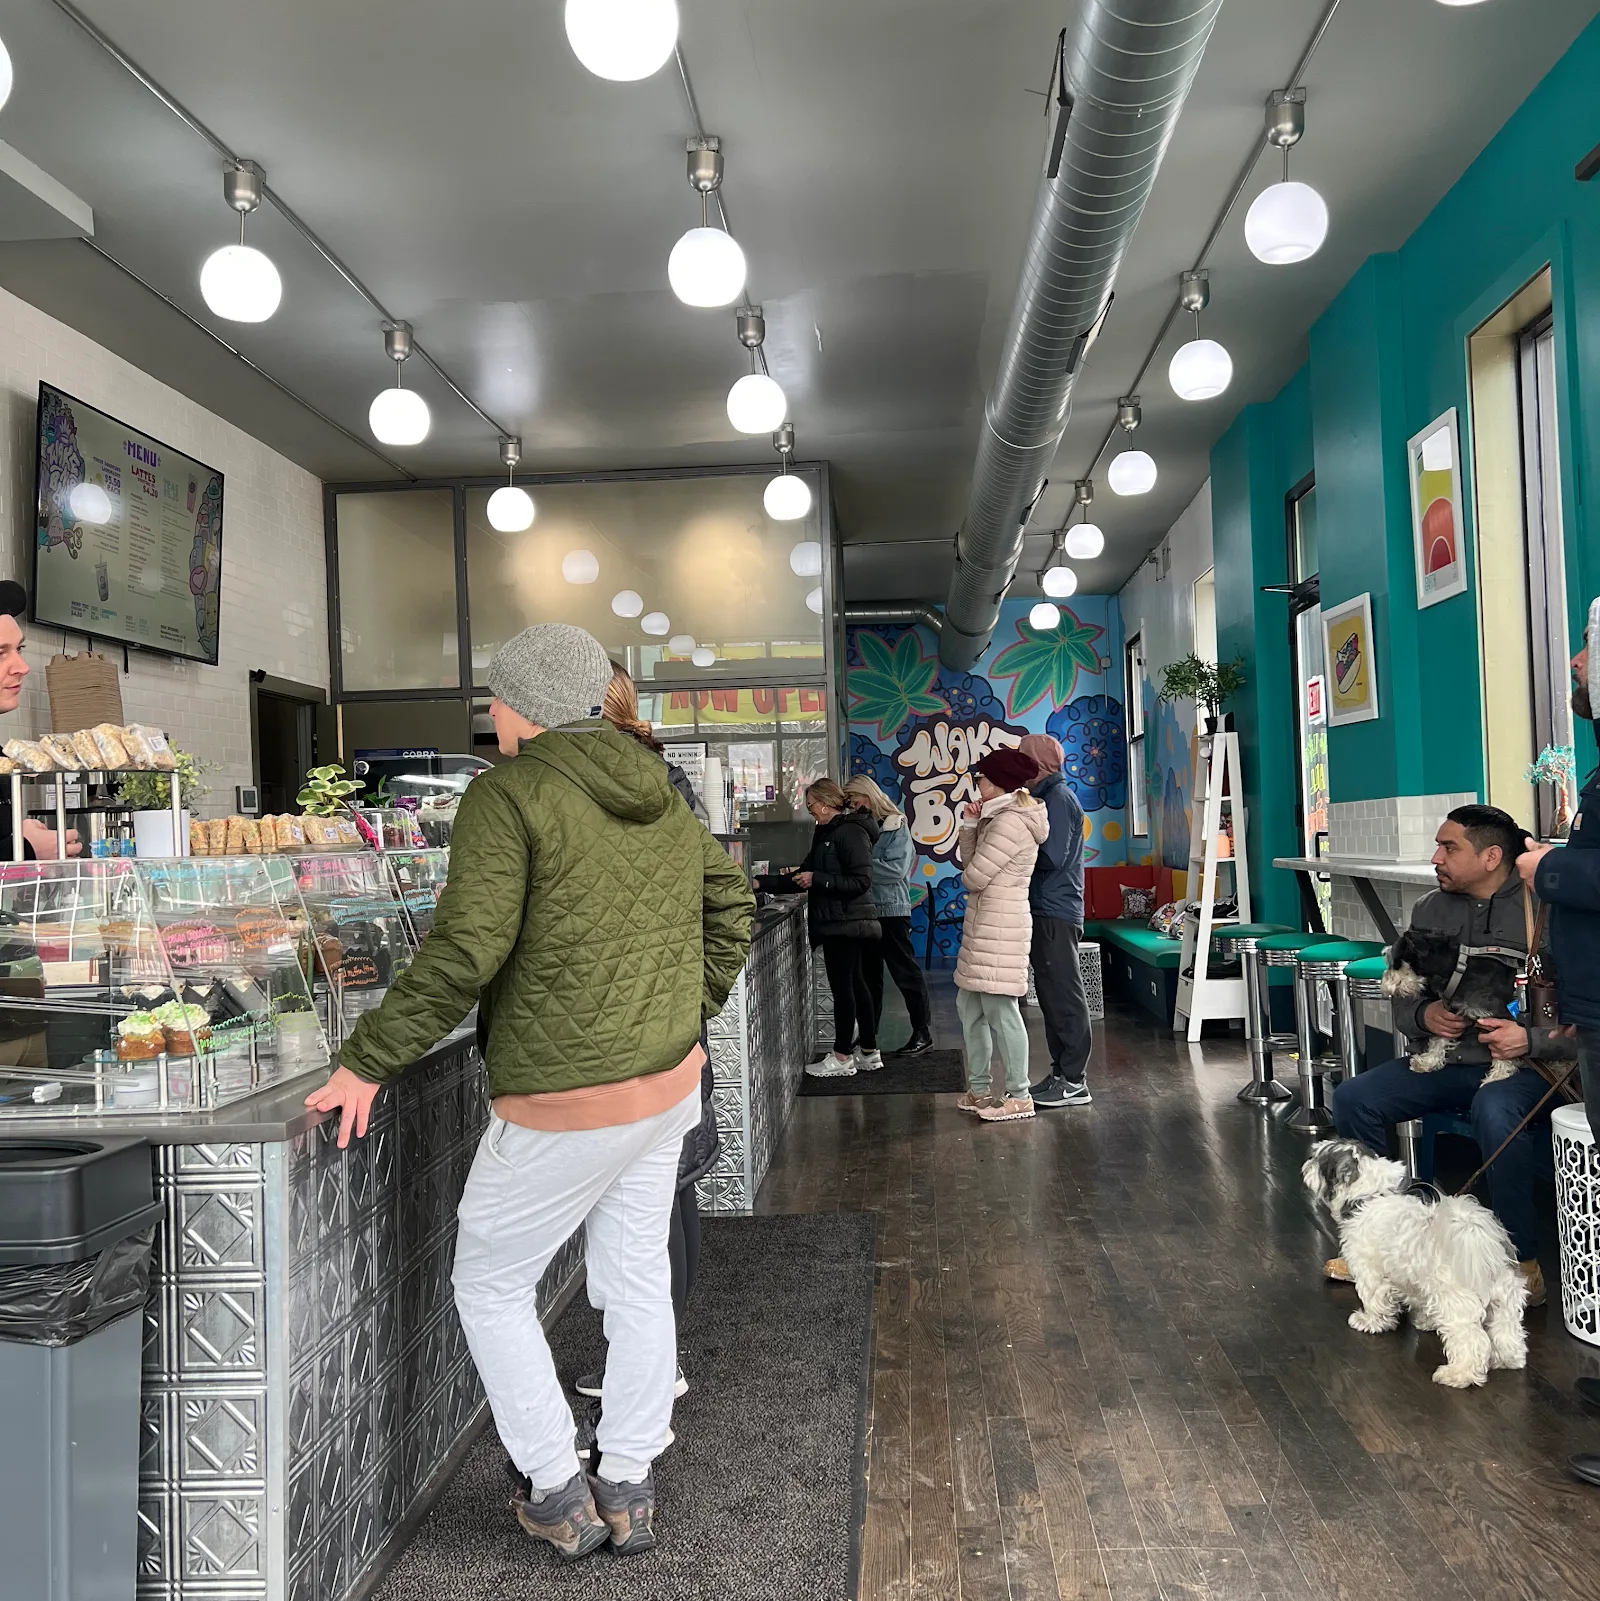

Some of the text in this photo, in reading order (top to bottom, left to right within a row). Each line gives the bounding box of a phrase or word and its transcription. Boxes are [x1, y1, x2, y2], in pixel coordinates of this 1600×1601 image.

[127, 440, 157, 468] MENU
[131, 465, 156, 484] LATTES
[143, 485, 159, 499] $4.20
[670, 688, 826, 715] NOW OPE
[402, 750, 436, 759] COBRA
